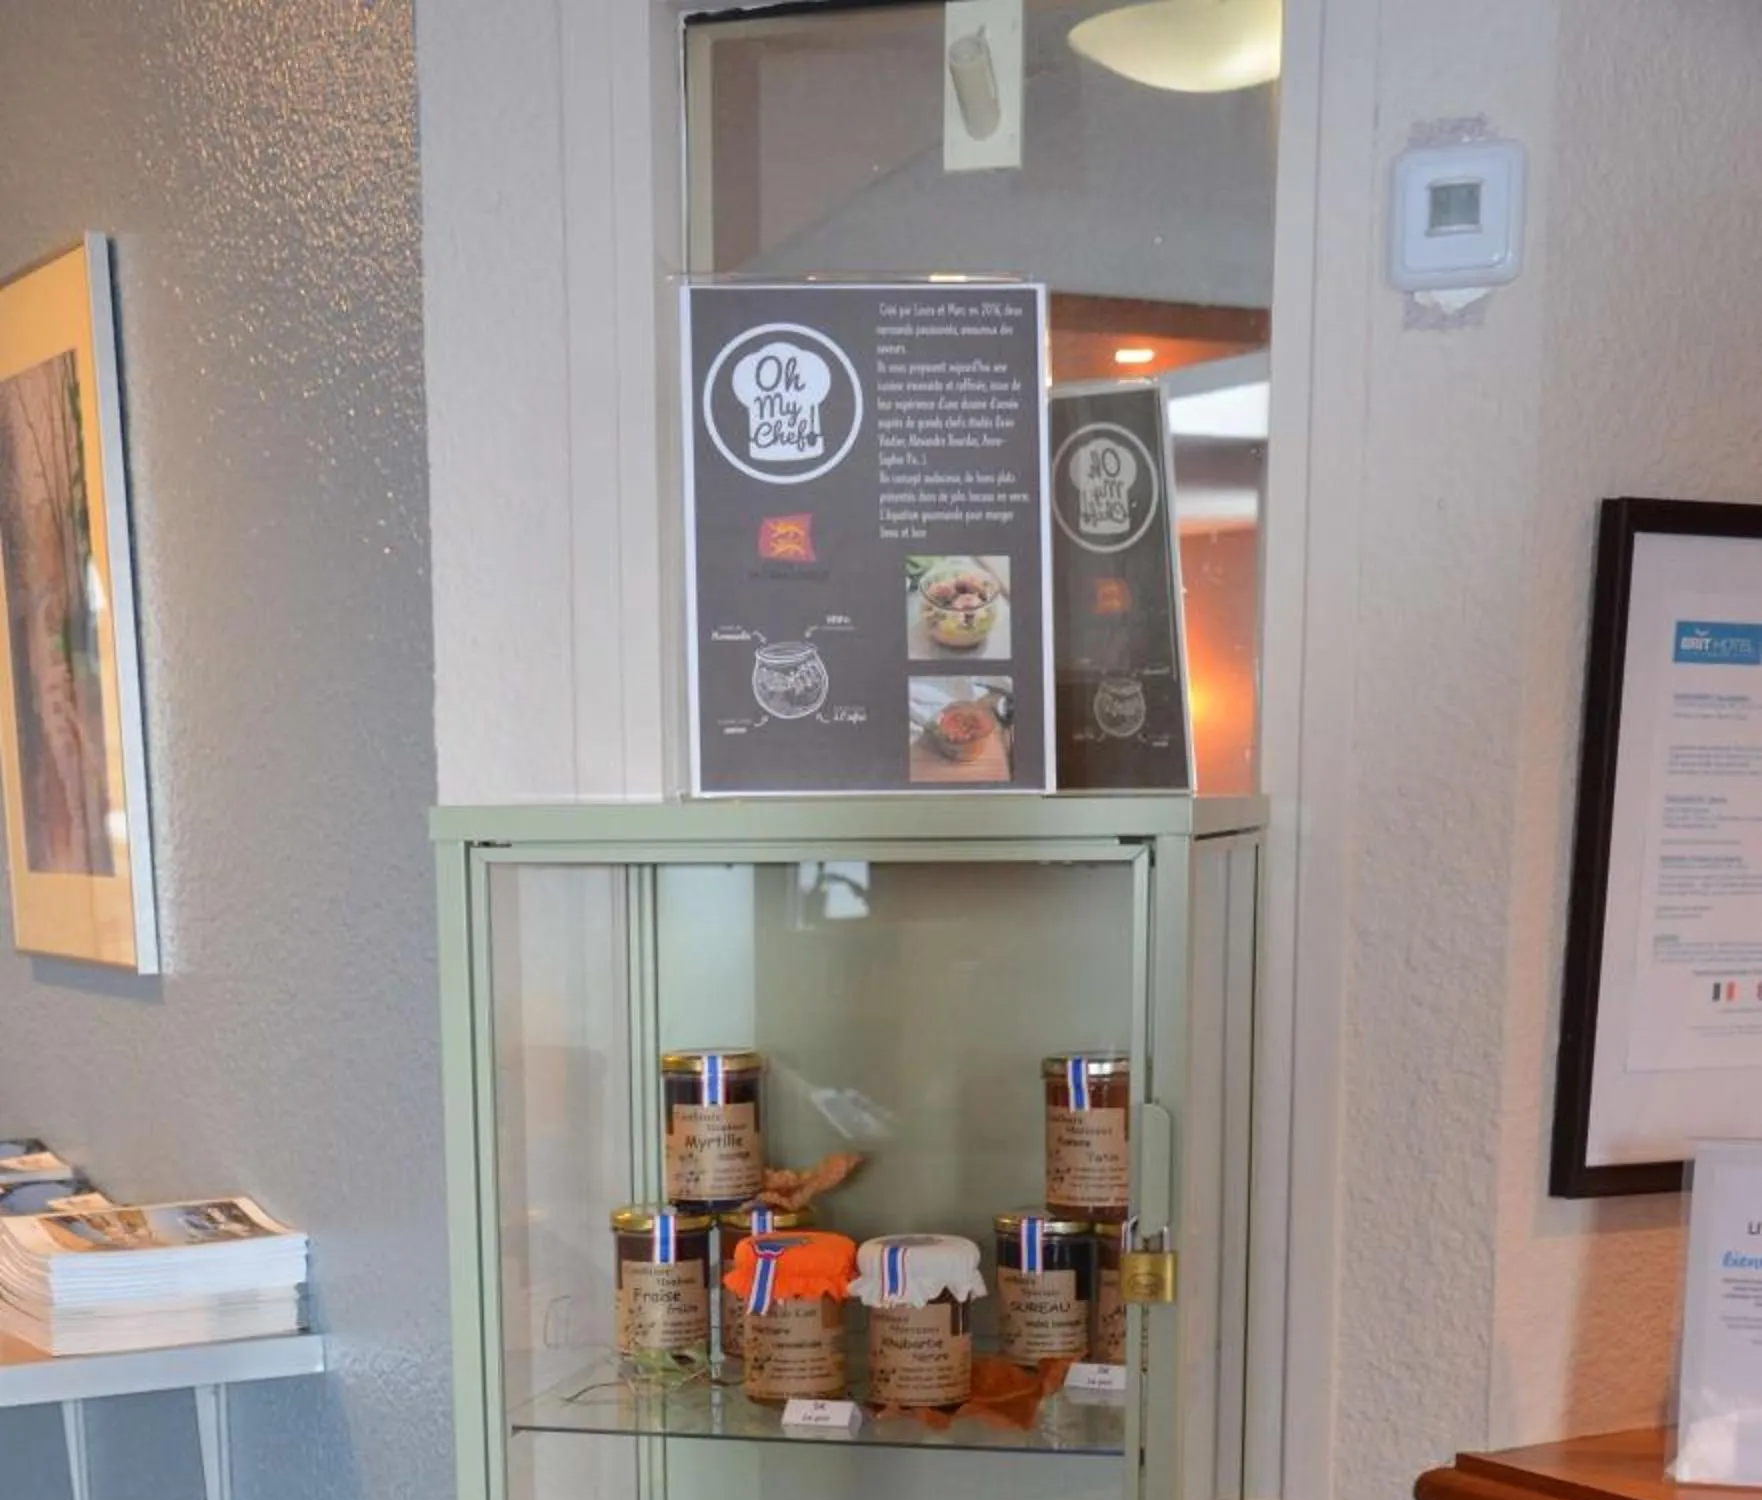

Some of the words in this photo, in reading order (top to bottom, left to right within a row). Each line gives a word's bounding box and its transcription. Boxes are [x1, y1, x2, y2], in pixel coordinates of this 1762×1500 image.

[755, 355, 806, 391] Oh
[754, 393, 802, 427] My
[754, 403, 818, 452] Chef!
[685, 1134, 744, 1153] Myrtille
[633, 1286, 682, 1304] Fraise
